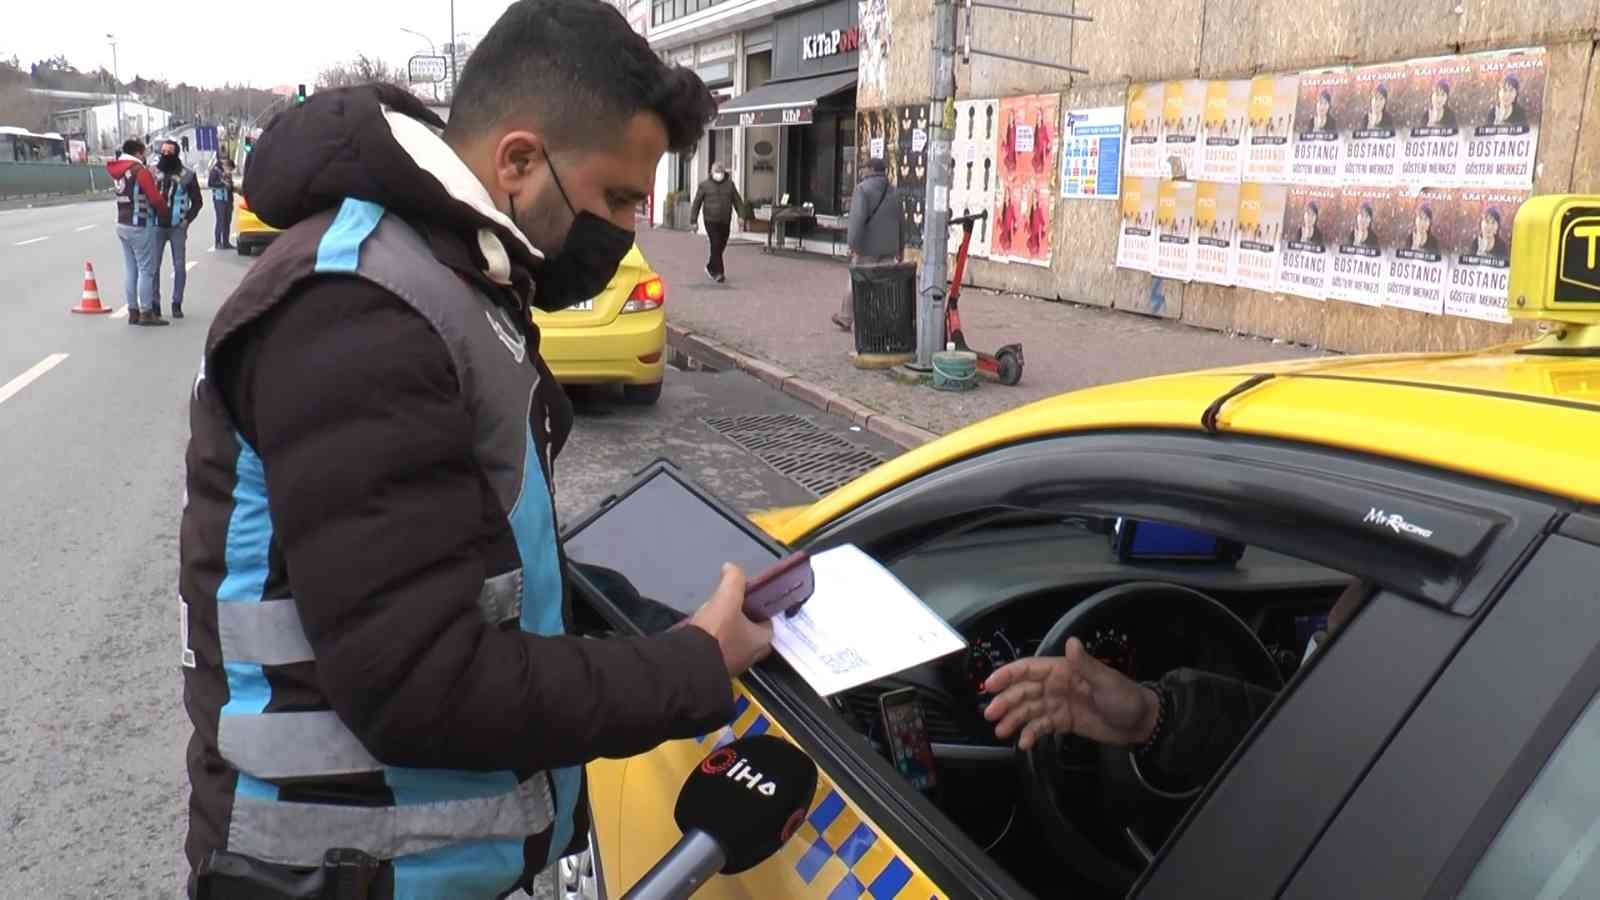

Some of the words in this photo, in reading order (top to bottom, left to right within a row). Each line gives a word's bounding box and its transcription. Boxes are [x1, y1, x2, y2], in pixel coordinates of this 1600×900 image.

[1294, 144, 1339, 160] BOSTANCI
[1347, 143, 1395, 159] BOSTANCI
[1404, 141, 1459, 157] BOSTANCI
[1468, 140, 1531, 157] BOSTANCI
[1282, 252, 1326, 273] BOSTANCI
[1334, 256, 1381, 278] BOSTANCI
[1390, 262, 1441, 284] BOSTANCI
[1452, 268, 1507, 290] BOSTANC
